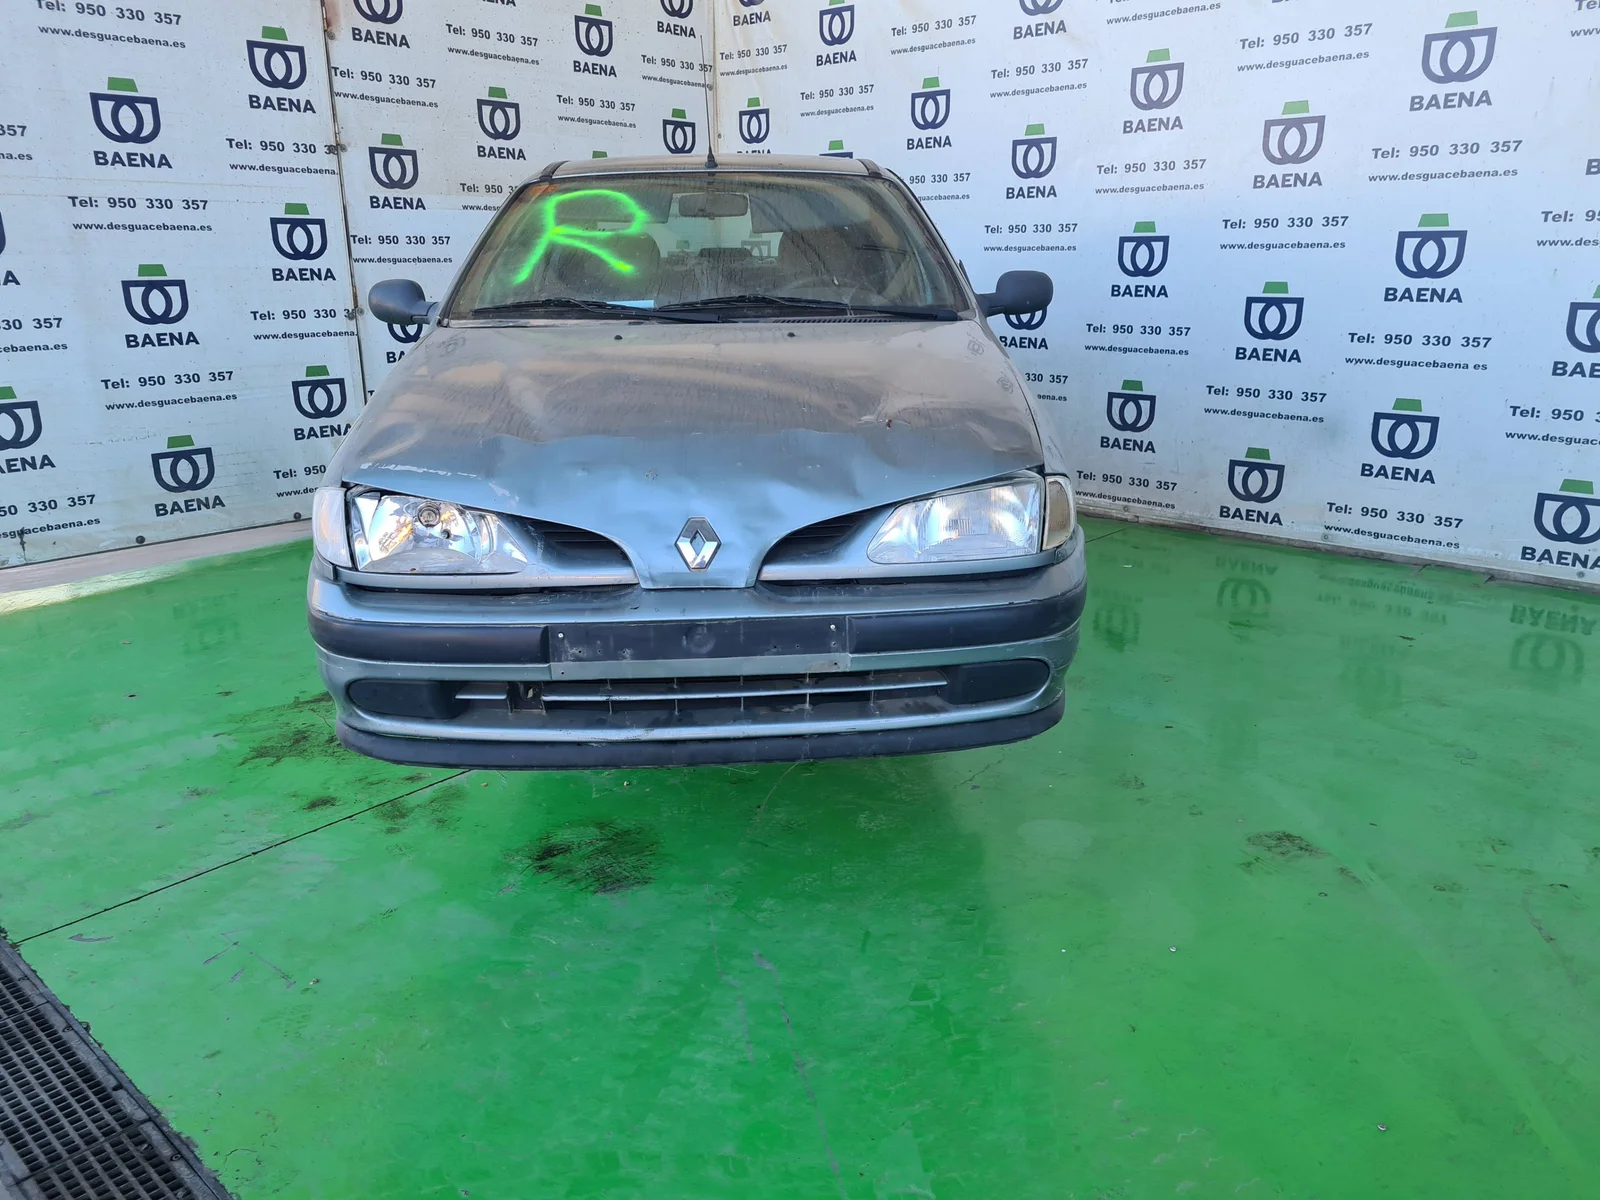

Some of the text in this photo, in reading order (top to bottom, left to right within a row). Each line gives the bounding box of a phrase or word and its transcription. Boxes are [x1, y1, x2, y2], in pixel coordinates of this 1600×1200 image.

[75, 2, 106, 17] 950
[115, 7, 145, 22] 330
[153, 11, 182, 26] 357
[733, 10, 771, 27] BAENA
[1106, 2, 1221, 25] www.desguacebaena.es
[657, 20, 696, 39] BAENA
[891, 14, 977, 37] Tel: 950 330 357
[1013, 19, 1067, 40] BAENA
[38, 26, 186, 49] www.desguacebaena.es
[351, 26, 411, 49] BAENA
[445, 23, 538, 47] Tel: 950 330 357
[1239, 22, 1373, 50] Tel: 950 330 357
[719, 44, 788, 61] Tel: 950 330 357
[890, 38, 976, 55] www.desguacebaena.es
[447, 47, 540, 66] www.desguacebaena.es
[641, 54, 695, 71] Tel: 950 330
[816, 50, 857, 67] BAENA
[1237, 51, 1370, 72] www.desguacebaena.es
[573, 60, 617, 78] BAENA
[990, 58, 1089, 79] Tel: 950 330 357
[331, 66, 436, 89] Tel: 950 330 357
[800, 84, 875, 101] Tel: 950 330 357
[989, 82, 1087, 98] www.desguacebaena.es
[248, 94, 317, 114] BAENA
[334, 90, 439, 109] www.desguacebaena.es
[556, 94, 636, 112] Tel: 950 330 357
[1409, 90, 1493, 112] BAENA
[1122, 115, 1183, 135] BAENA
[225, 138, 252, 150] Tel:
[259, 140, 285, 152] 950
[292, 142, 317, 154] 330
[907, 135, 952, 150] BAENA
[1371, 139, 1523, 159] Tel: 950 330 357
[93, 150, 173, 169] BAENA
[477, 145, 527, 161] BAENA
[1096, 158, 1207, 175] Tel: 950 330 357
[909, 172, 971, 185] 950 330 357
[1252, 171, 1323, 189] BAENA
[1368, 169, 1518, 182] www.desguacebaena.es
[459, 182, 479, 193] Tel:
[484, 184, 503, 194] 950
[1006, 185, 1057, 200] BAENA
[1095, 183, 1205, 195] www.desguacebaena.es
[67, 196, 208, 210] Tel: 950 330 357
[369, 195, 426, 211] BAENA
[1222, 215, 1349, 229] Tel: 950 330 357
[1541, 210, 1574, 223] Tel:
[72, 221, 213, 233] www.desguacebaena.es
[984, 223, 1078, 234] Tel: 950 330 357
[351, 234, 451, 245] Tel: 950 330 357
[510, 187, 650, 286] R
[983, 244, 1077, 253] www.desguacebaena.es
[1219, 241, 1346, 251] www.desguacebaena.es
[353, 255, 453, 265] www.desguacebaena.es
[271, 267, 337, 282] BAENA
[1111, 284, 1169, 298] BAENA
[1383, 287, 1463, 303] BAENA
[32, 317, 63, 329] 357
[250, 310, 275, 321] Tel:
[282, 309, 306, 320] 950
[313, 308, 337, 319] 330
[1086, 323, 1191, 337] Tel: 950 330 357
[124, 331, 200, 349] BAENA
[999, 335, 1049, 350] BAENA
[1348, 332, 1492, 348] Tel: 950 330 357
[1084, 344, 1189, 356] www.desguacebaena.es
[1235, 346, 1302, 363] BAENA
[100, 370, 234, 390] Tel: 950 330 357
[1025, 372, 1069, 384] 330 357
[105, 394, 238, 411] www.desguacebaena.es
[1206, 385, 1327, 403] Tel: 950 330 357
[1204, 407, 1324, 423] www.desguacebaena.es
[1509, 405, 1541, 418] Tel:
[1551, 408, 1584, 422] 950
[1100, 436, 1156, 454] BAENA
[272, 464, 327, 480] Tel: 950
[1076, 470, 1178, 491] Tel: 950 330 357
[1360, 463, 1436, 485] BAENA
[27, 494, 96, 513] 330 357
[154, 495, 226, 517] BAENA
[1075, 490, 1176, 510] www.desguacebaena.es
[1219, 505, 1283, 526] BAENA
[1326, 502, 1464, 529] Tel: 950 330 357
[1324, 524, 1460, 549] www.desguacebaena.es
